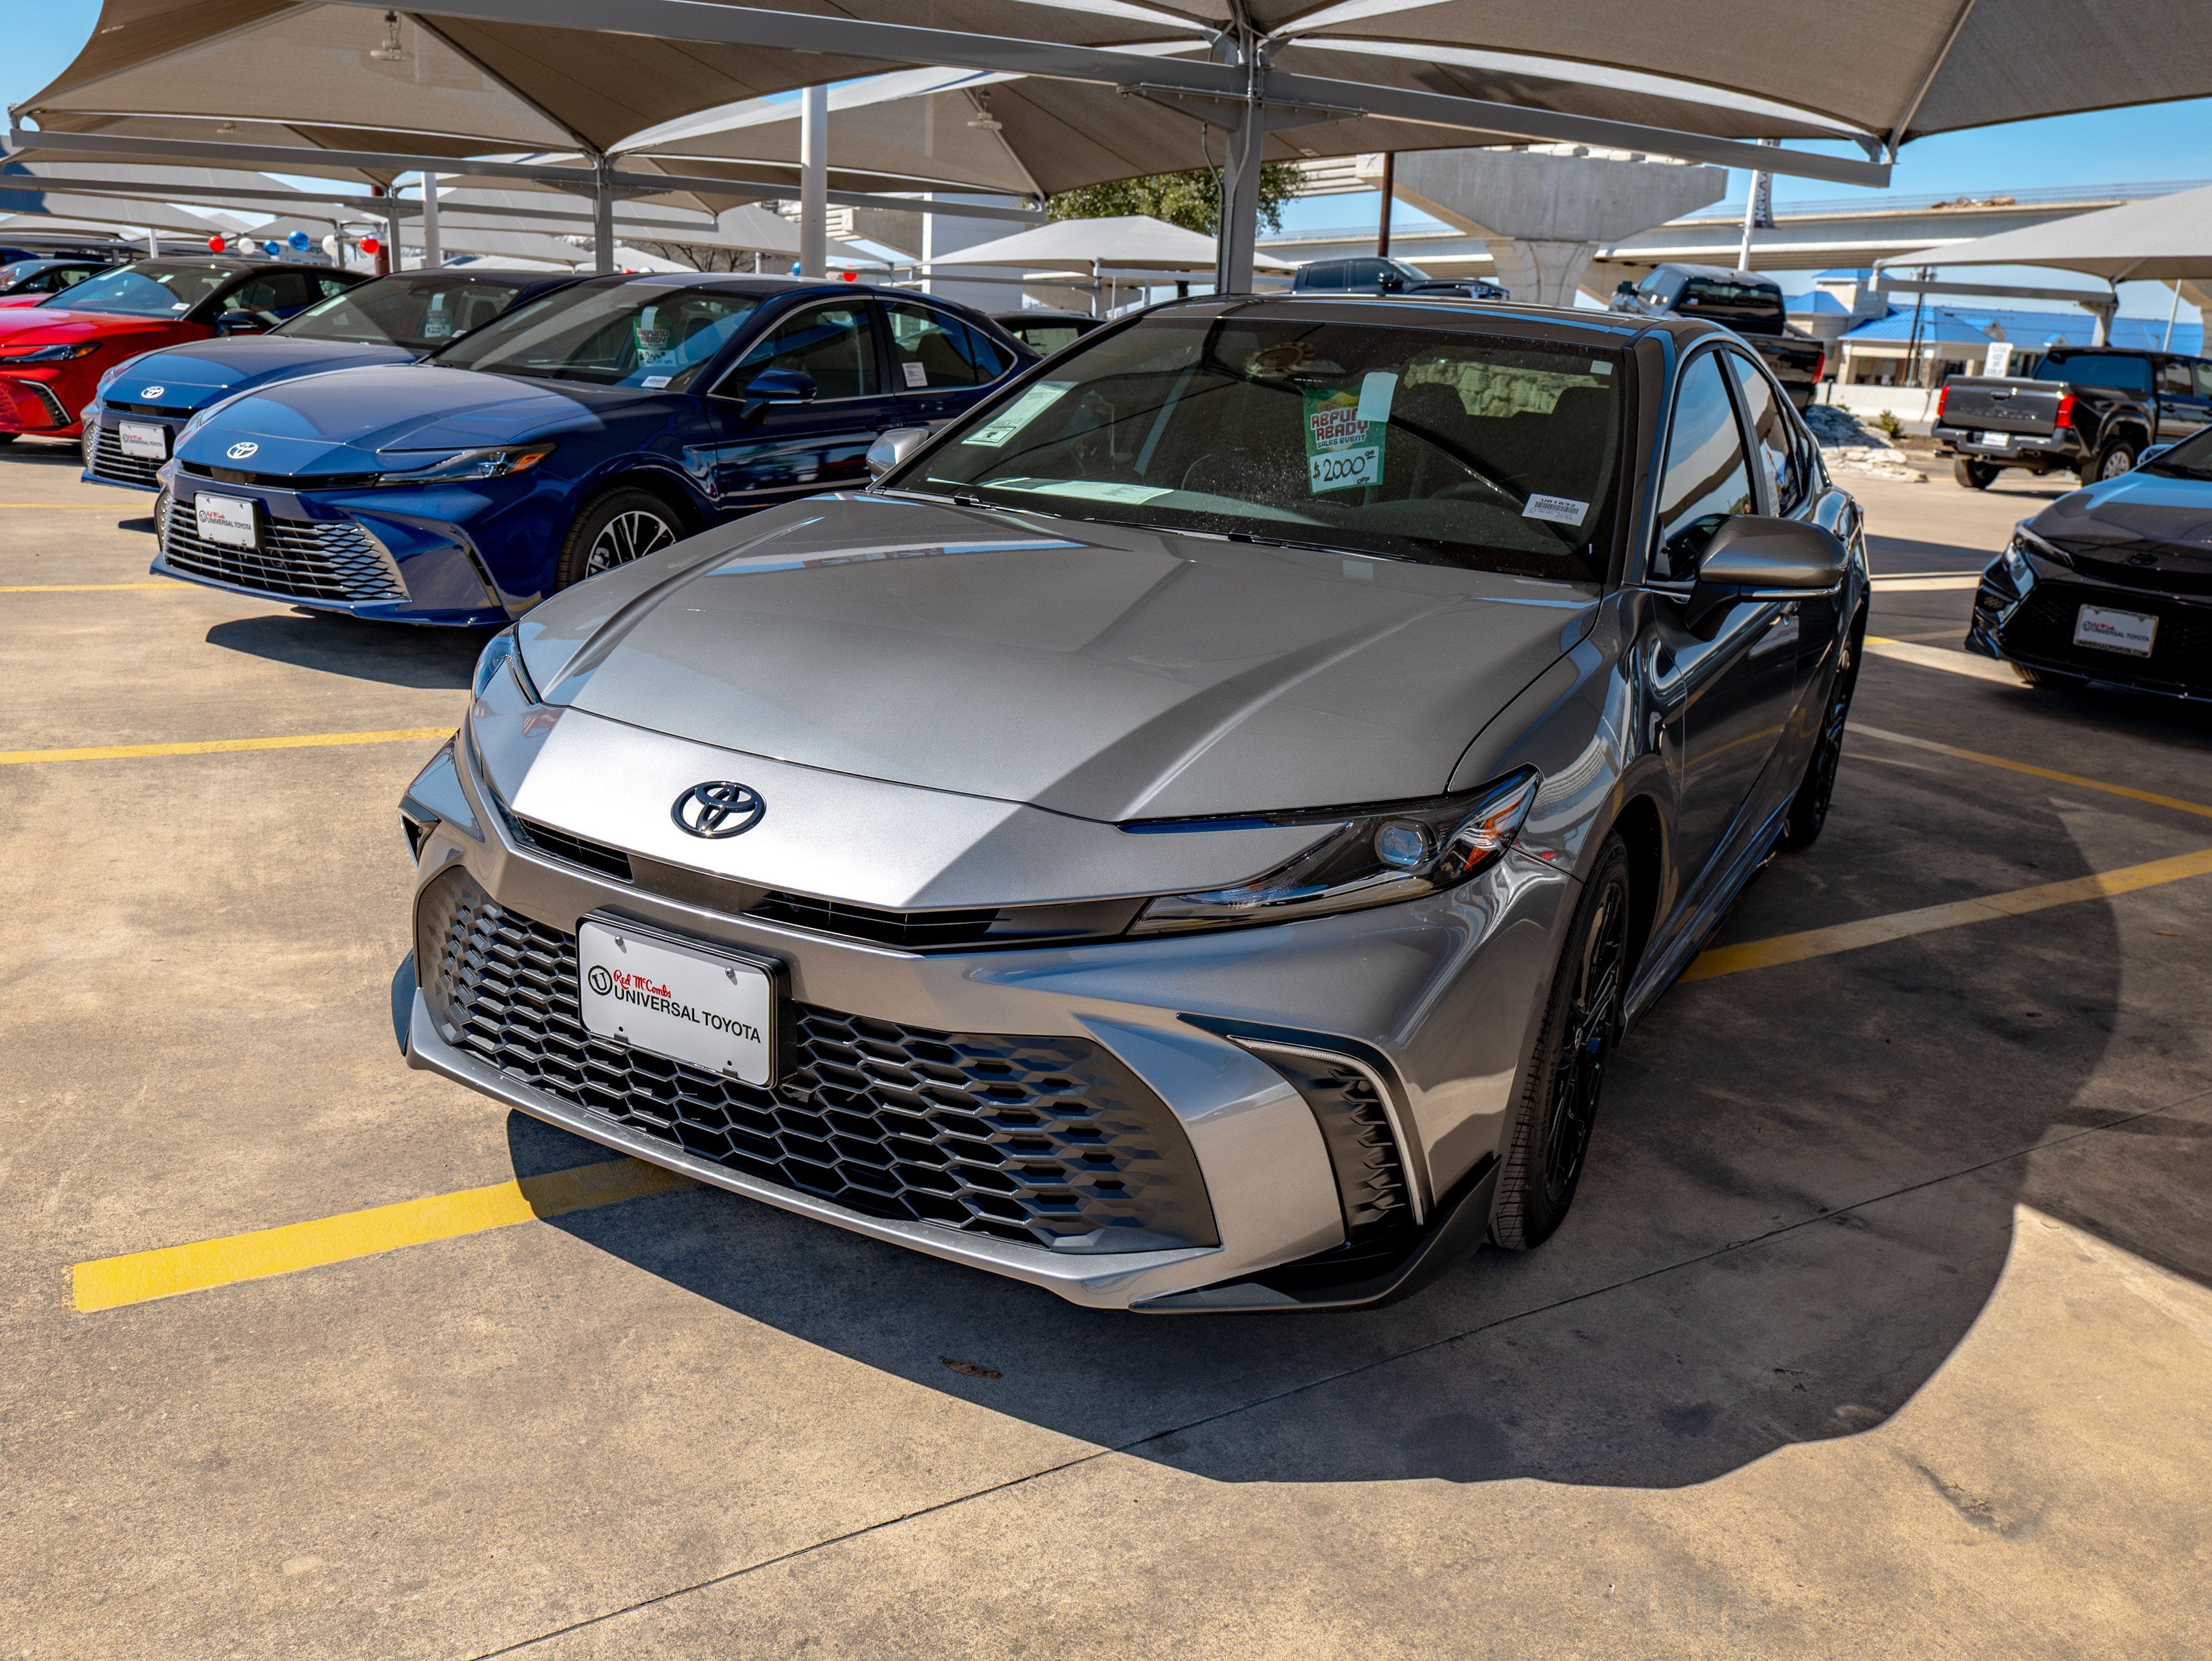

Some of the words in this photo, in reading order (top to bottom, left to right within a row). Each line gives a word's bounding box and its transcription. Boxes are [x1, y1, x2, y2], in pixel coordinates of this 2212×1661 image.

[1316, 419, 1369, 441] READY
[1317, 439, 1338, 448] SALES
[1340, 434, 1366, 444] EVENT
[1541, 498, 1576, 507] U61832
[207, 517, 234, 527] UNIVERSAL
[234, 521, 252, 530] TOYOTA
[613, 969, 631, 990] Red
[632, 974, 672, 998] McCombs
[614, 985, 700, 1024] UNIVERSAL
[702, 1011, 762, 1044] TOYOTA
